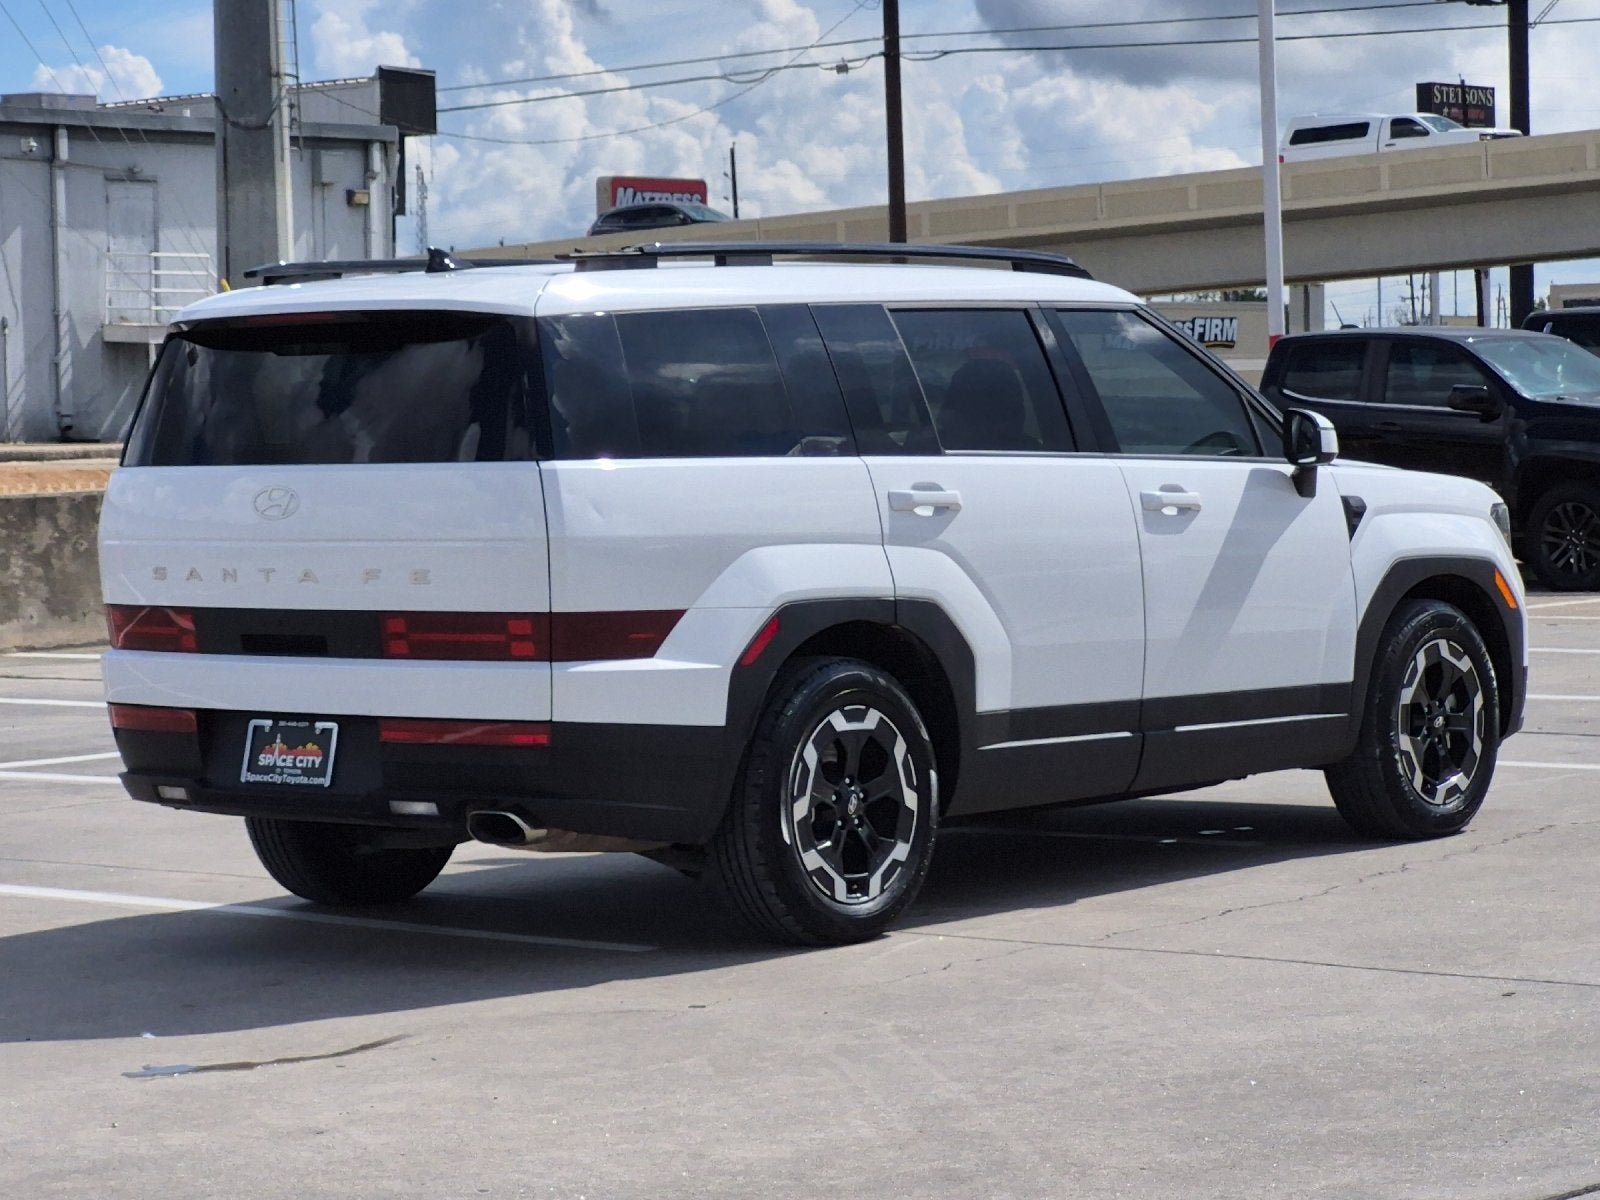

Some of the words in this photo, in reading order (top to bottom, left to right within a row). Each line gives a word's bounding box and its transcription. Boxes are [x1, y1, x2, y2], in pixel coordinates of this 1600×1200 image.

[1433, 85, 1493, 106] STETSONS
[617, 187, 701, 207] MATTRESS
[151, 565, 320, 584] SANTA
[363, 567, 432, 585] FE
[258, 754, 294, 766] SPACE
[296, 756, 322, 768] CITY
[246, 773, 324, 784] SpaceCityToyota.com
